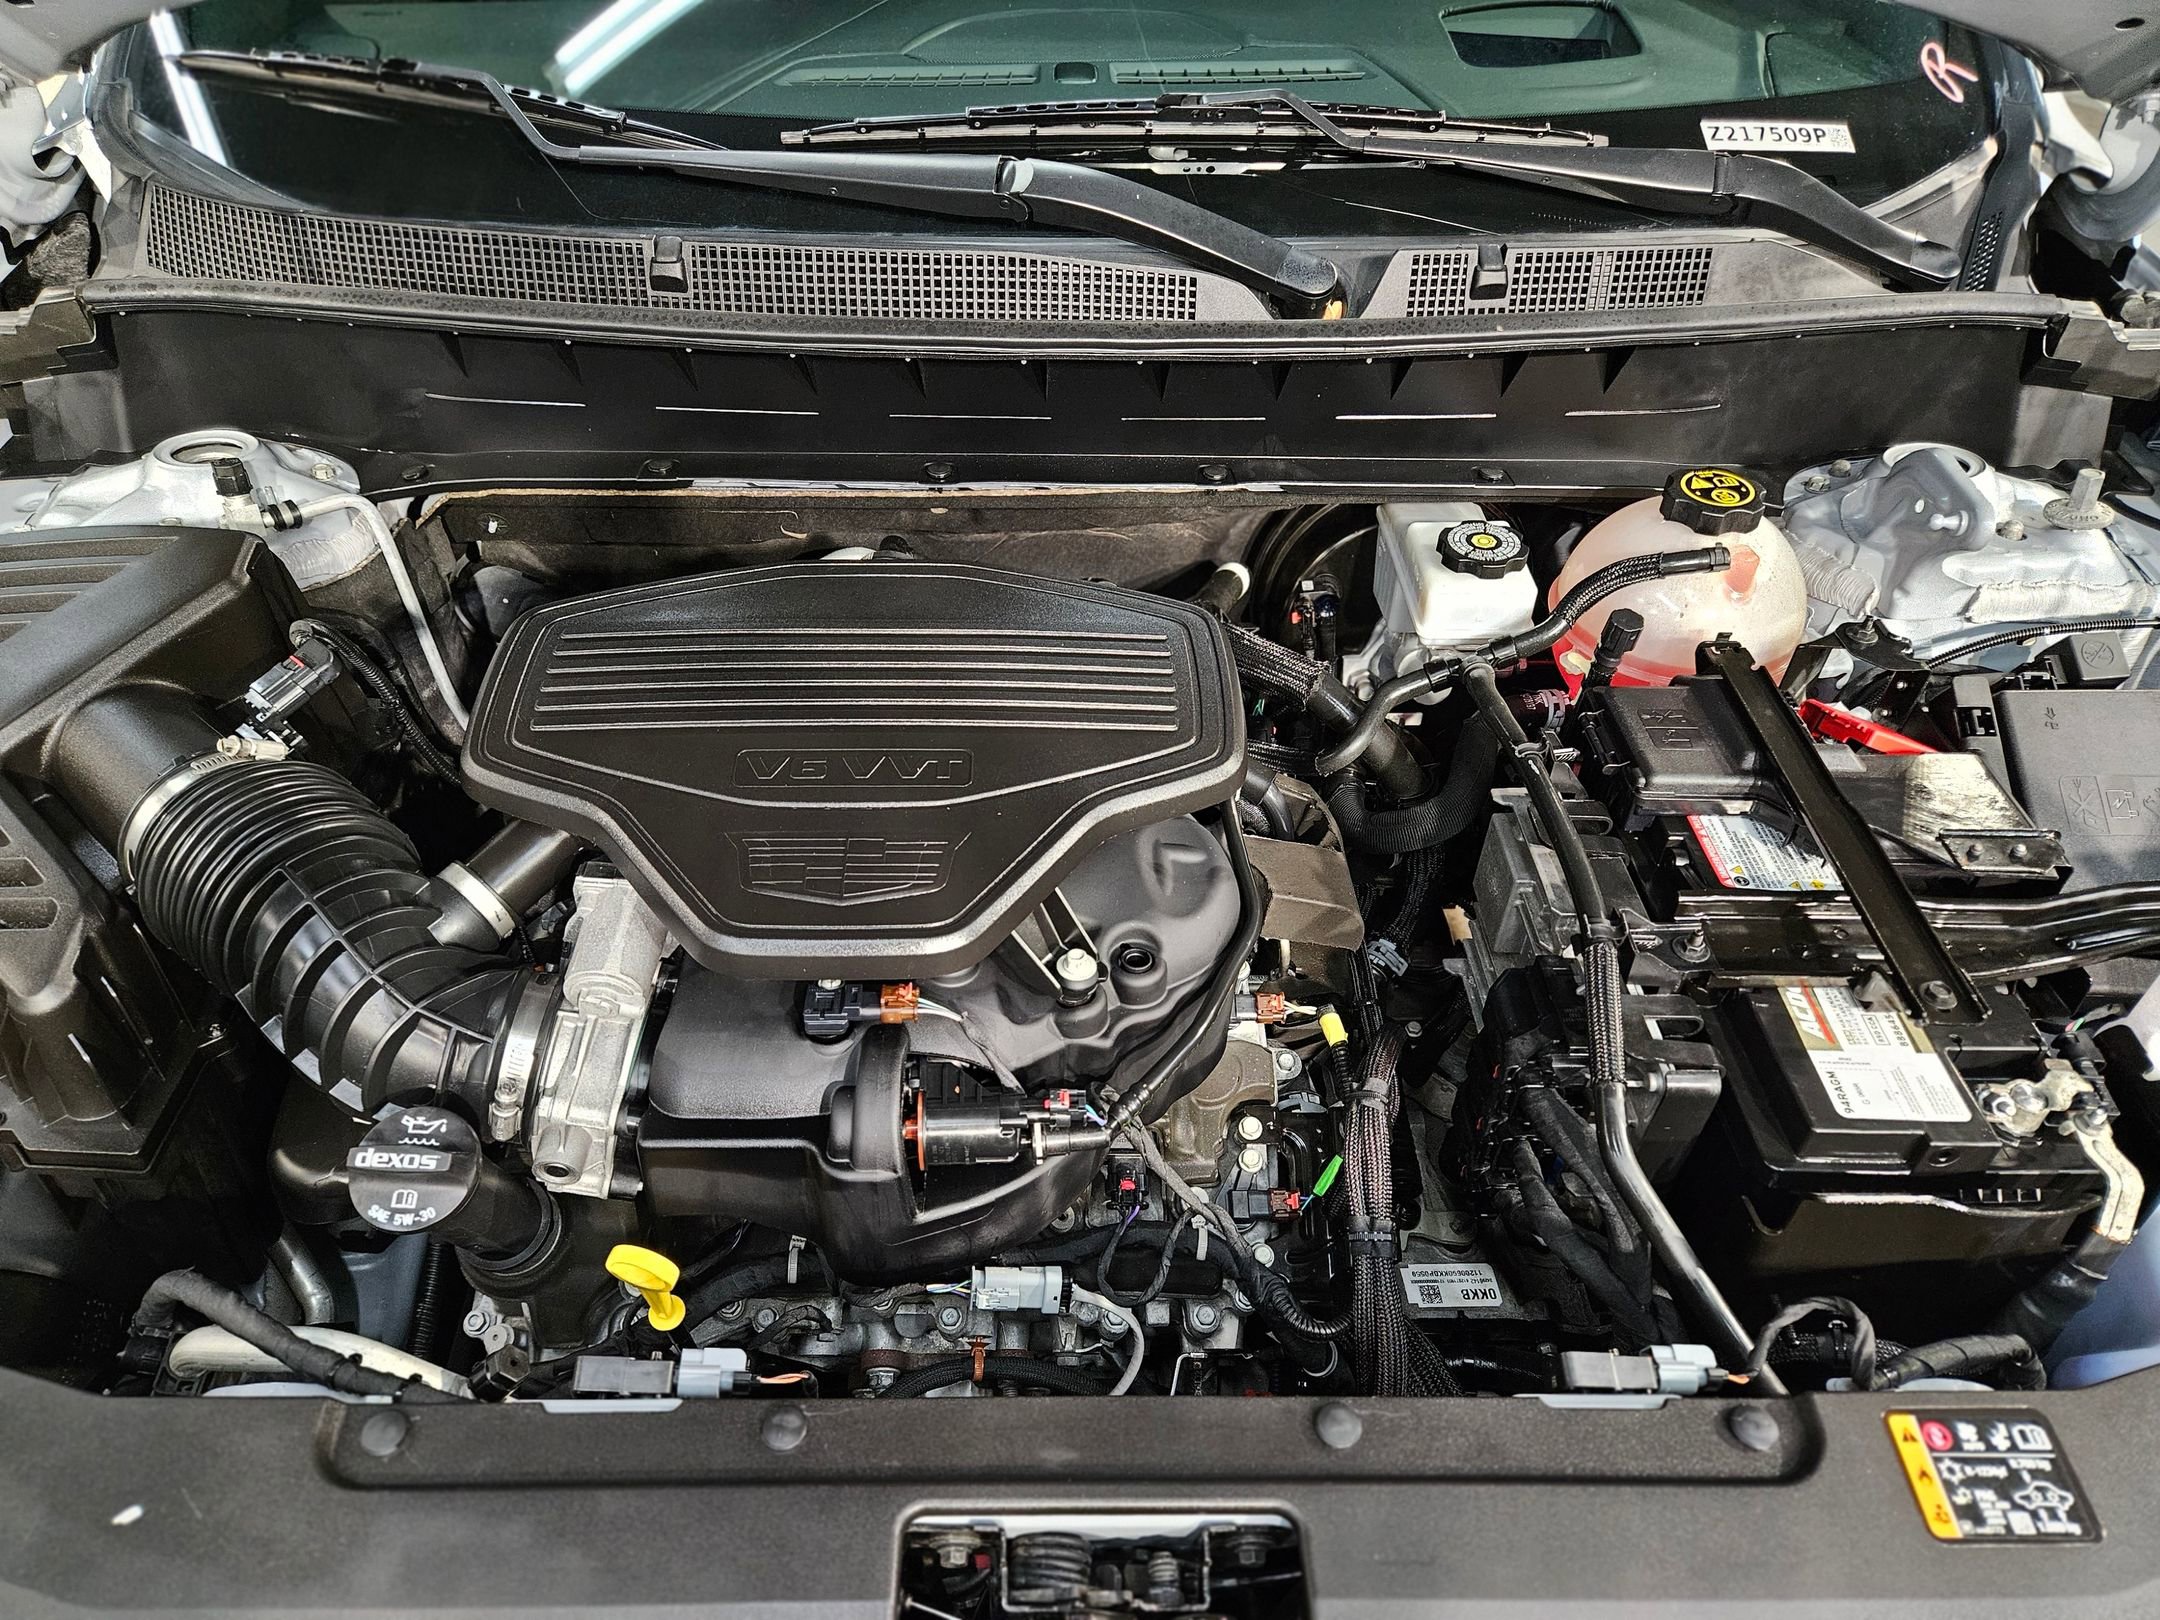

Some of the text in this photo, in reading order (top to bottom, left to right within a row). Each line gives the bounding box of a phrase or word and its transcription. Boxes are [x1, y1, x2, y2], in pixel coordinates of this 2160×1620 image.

[1707, 126, 1827, 144] Z217509P
[747, 755, 963, 779] V6 VVT
[1826, 1071, 1855, 1113] 94RAGM
[354, 1147, 442, 1170] dexos
[367, 1204, 436, 1226] SAE 5W-30
